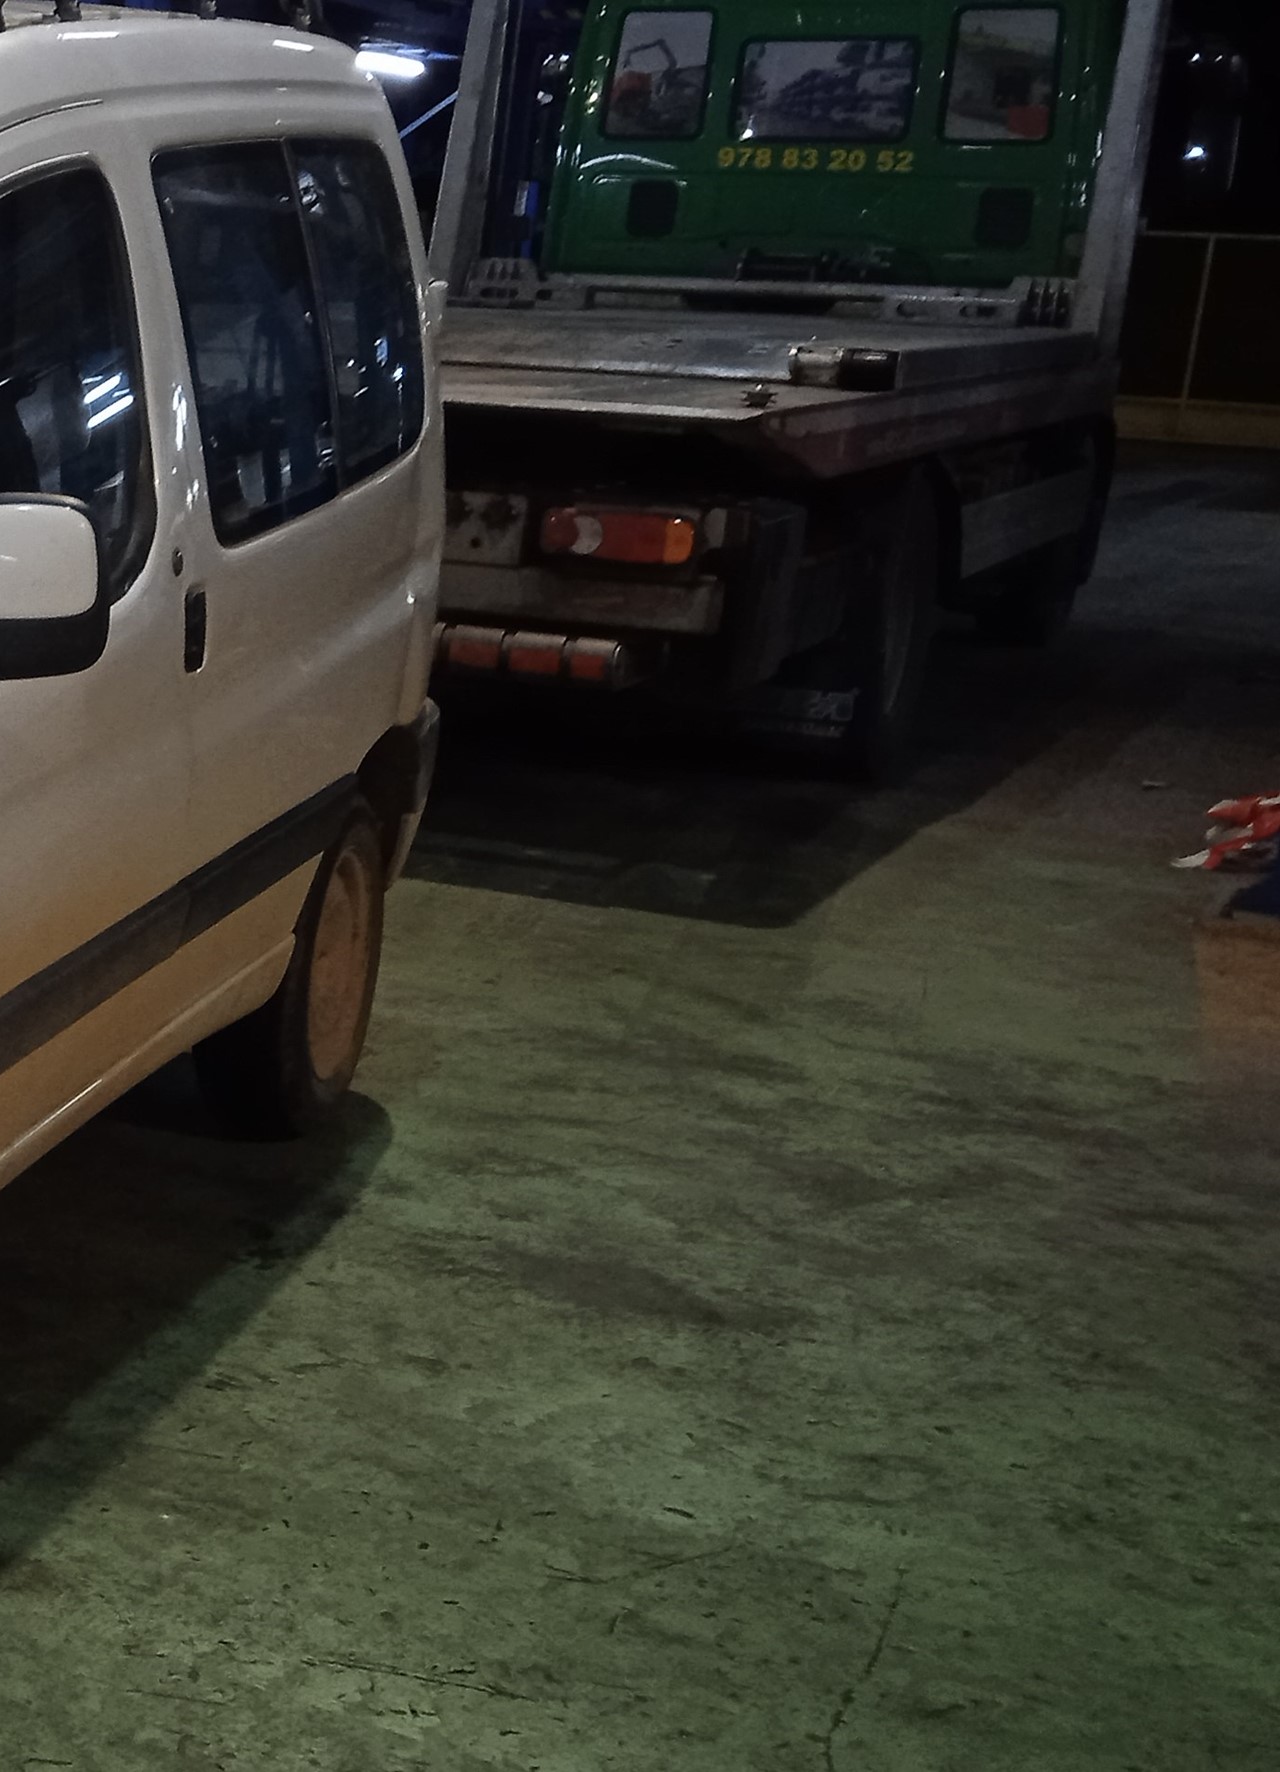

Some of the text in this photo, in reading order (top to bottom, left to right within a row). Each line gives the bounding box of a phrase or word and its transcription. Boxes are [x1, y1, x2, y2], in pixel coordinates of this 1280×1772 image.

[717, 146, 915, 173] 978 83 20 52
